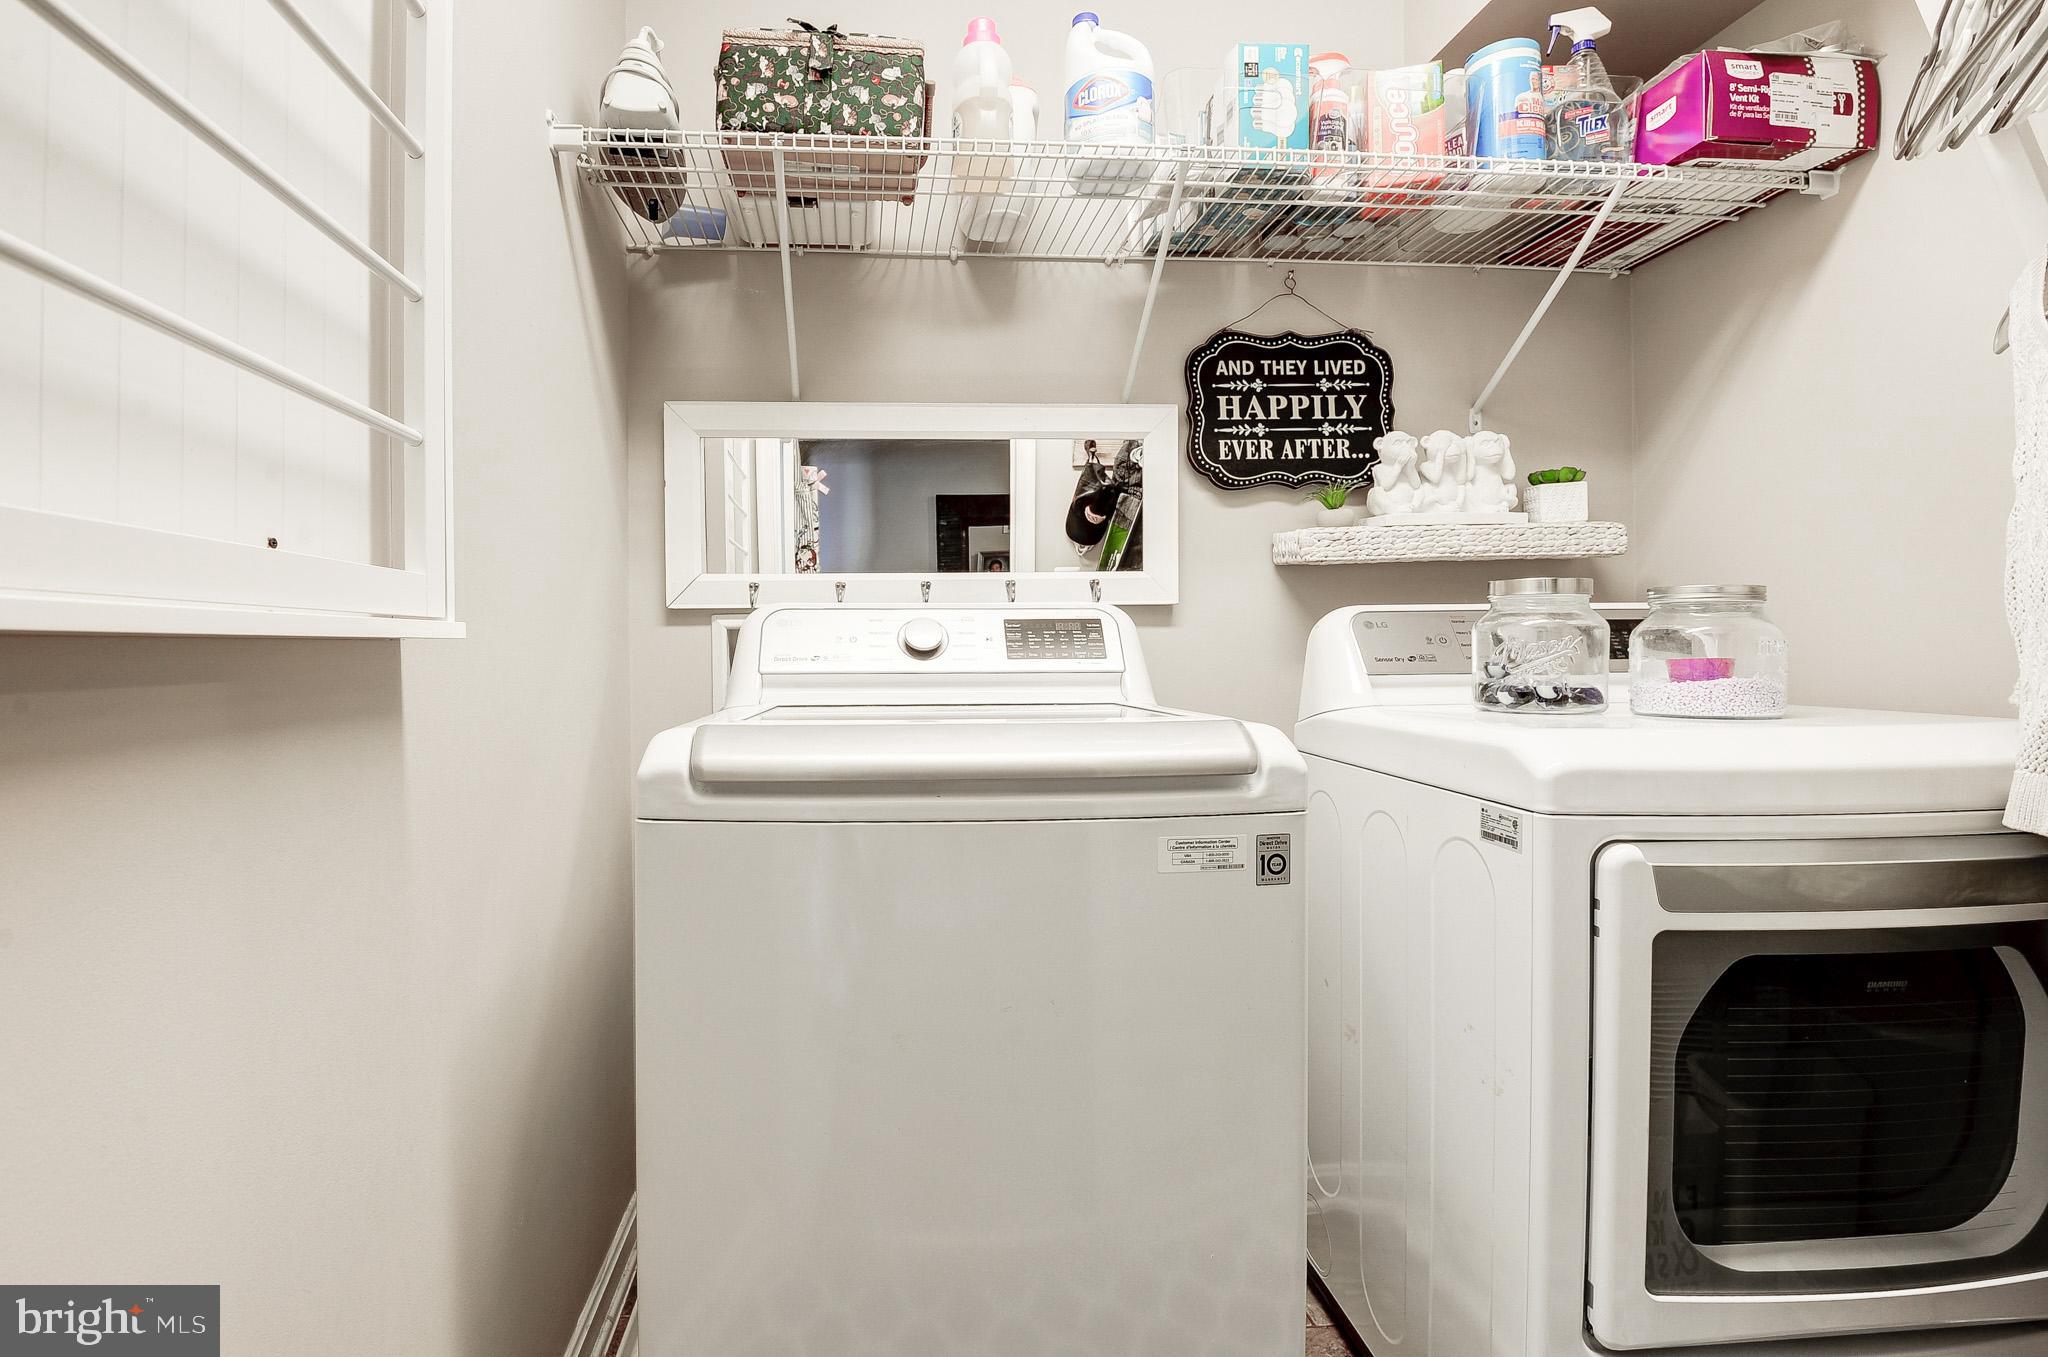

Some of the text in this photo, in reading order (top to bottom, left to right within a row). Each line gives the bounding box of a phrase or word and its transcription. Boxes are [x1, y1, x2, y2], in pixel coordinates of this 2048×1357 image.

[1731, 63, 1758, 71] smart
[1077, 82, 1124, 107] CLOROX
[1729, 93, 1760, 103] Vent Kit
[1577, 116, 1607, 136] TILEX
[1216, 359, 1366, 376] AND THEY LIVED
[1216, 394, 1368, 421] HAPPILY
[1218, 438, 1371, 461] EVER AFTER...
[1260, 853, 1287, 876] 10
